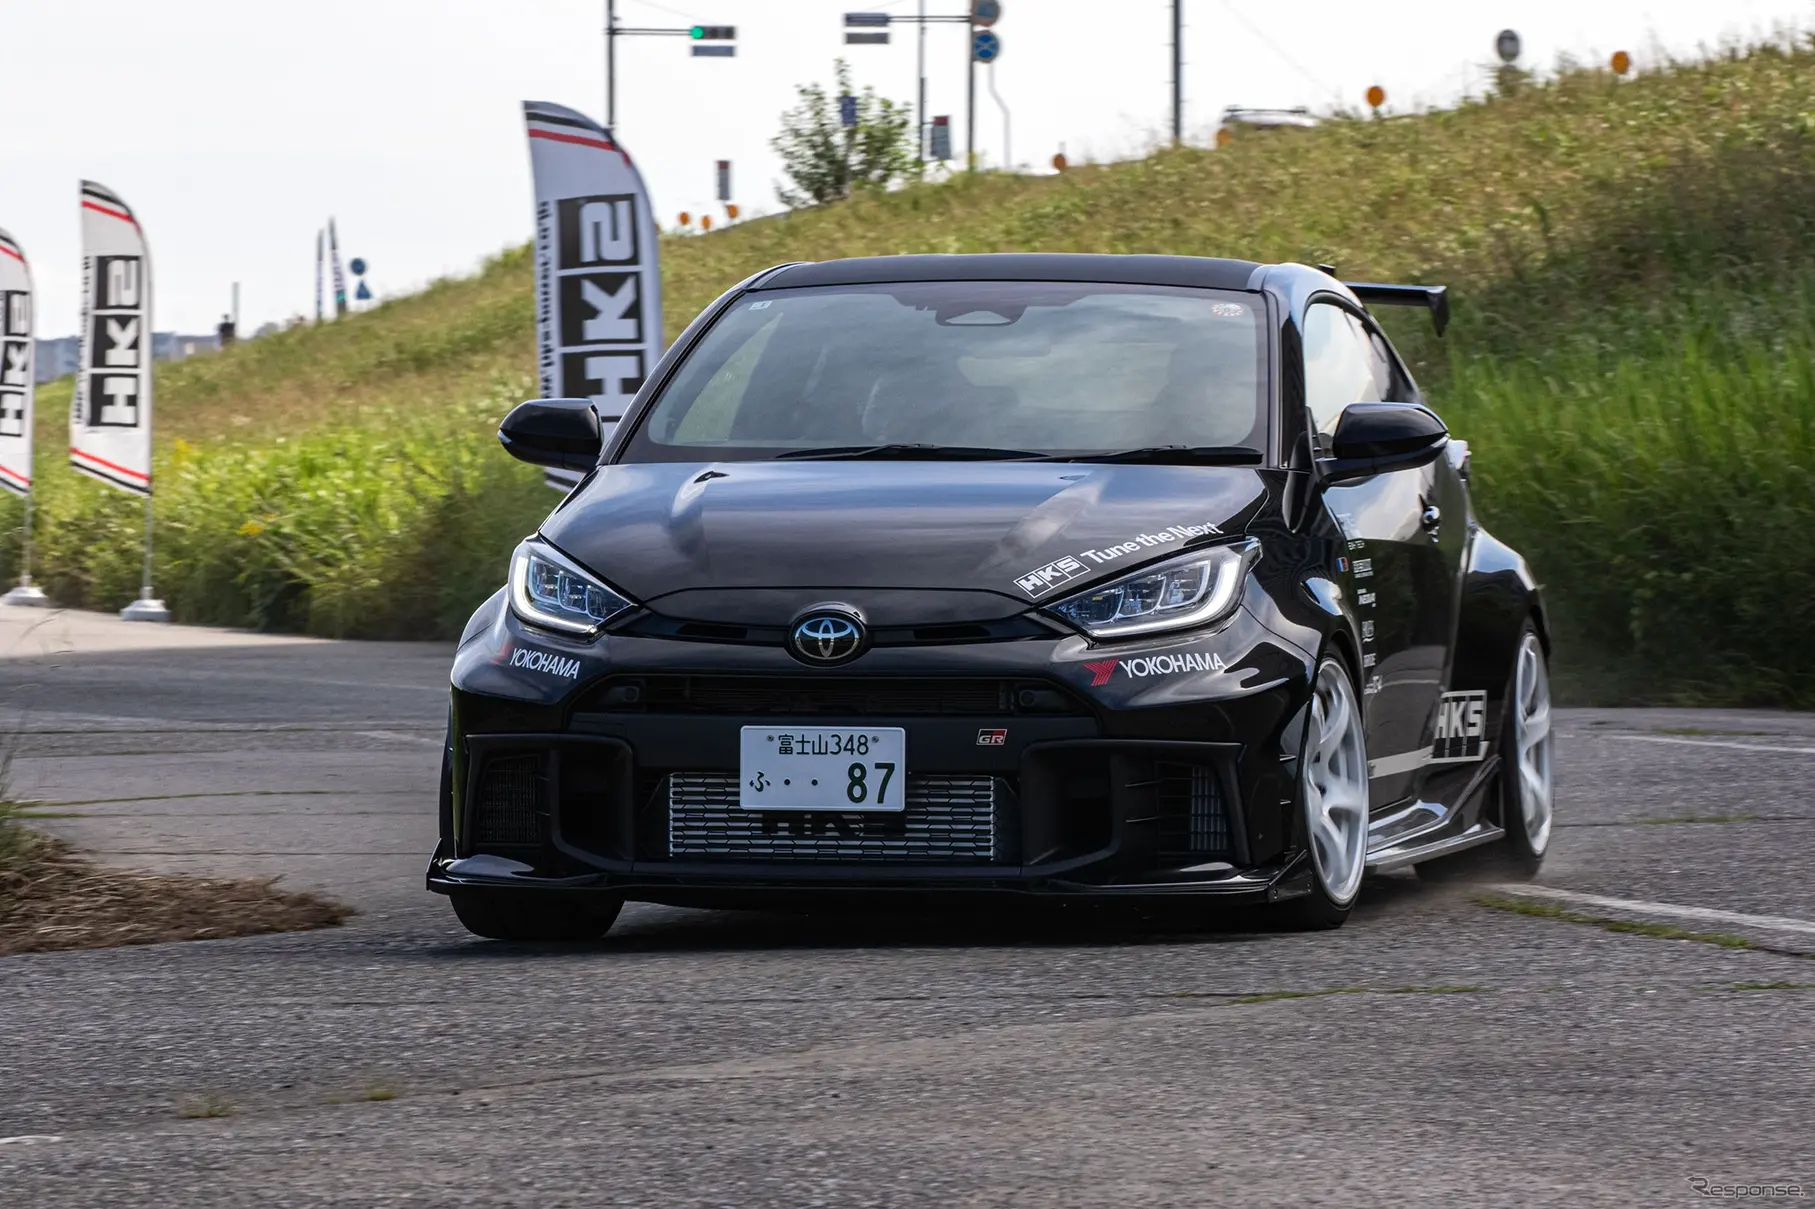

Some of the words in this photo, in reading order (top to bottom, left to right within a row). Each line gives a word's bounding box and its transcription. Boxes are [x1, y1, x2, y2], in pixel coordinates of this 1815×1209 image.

[1080, 540, 1142, 564] Tune
[1136, 530, 1172, 547] the
[1167, 522, 1223, 542] Next
[1016, 556, 1083, 593] HKS
[510, 648, 581, 680] YOKOHAMA
[1119, 652, 1226, 679] YOKOHAMA
[1436, 701, 1484, 739] HKS
[978, 734, 1005, 744] GR
[847, 762, 896, 804] 87
